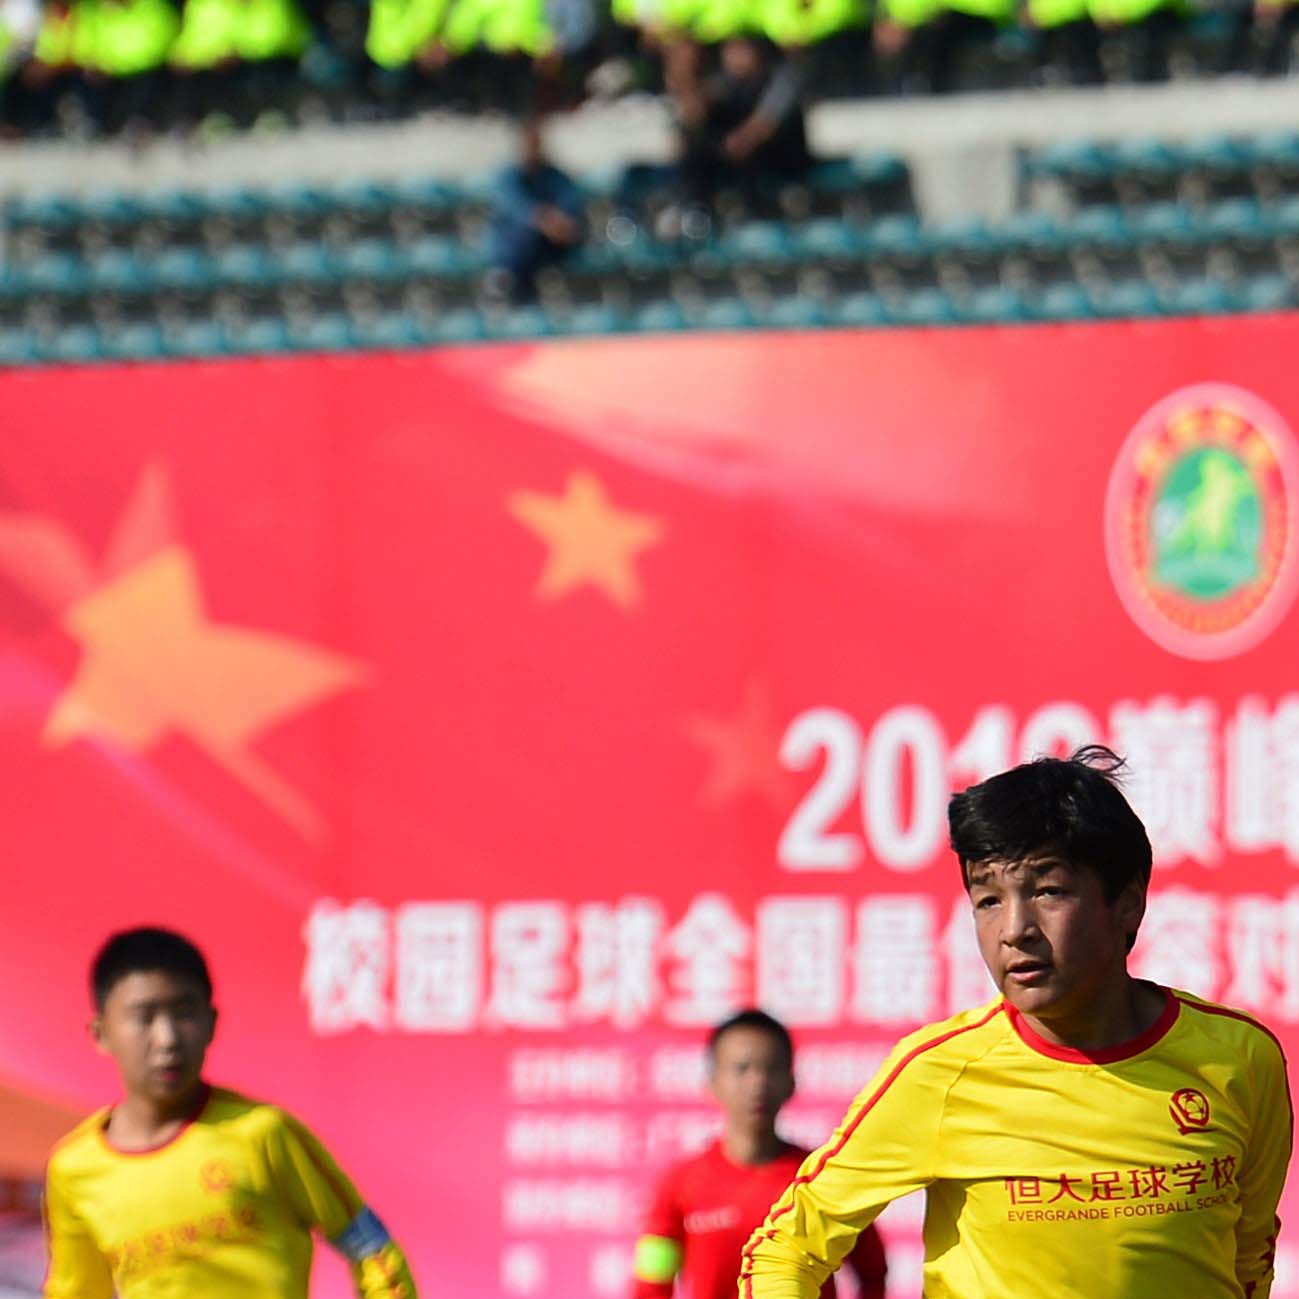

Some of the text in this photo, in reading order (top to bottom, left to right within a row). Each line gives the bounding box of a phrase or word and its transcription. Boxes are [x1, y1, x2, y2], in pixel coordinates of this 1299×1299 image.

[1005, 1154, 1237, 1205] 恒大足球学校
[1007, 1207, 1109, 1222] EVERGRANDE
[1114, 1201, 1192, 1218] FOOTBALL
